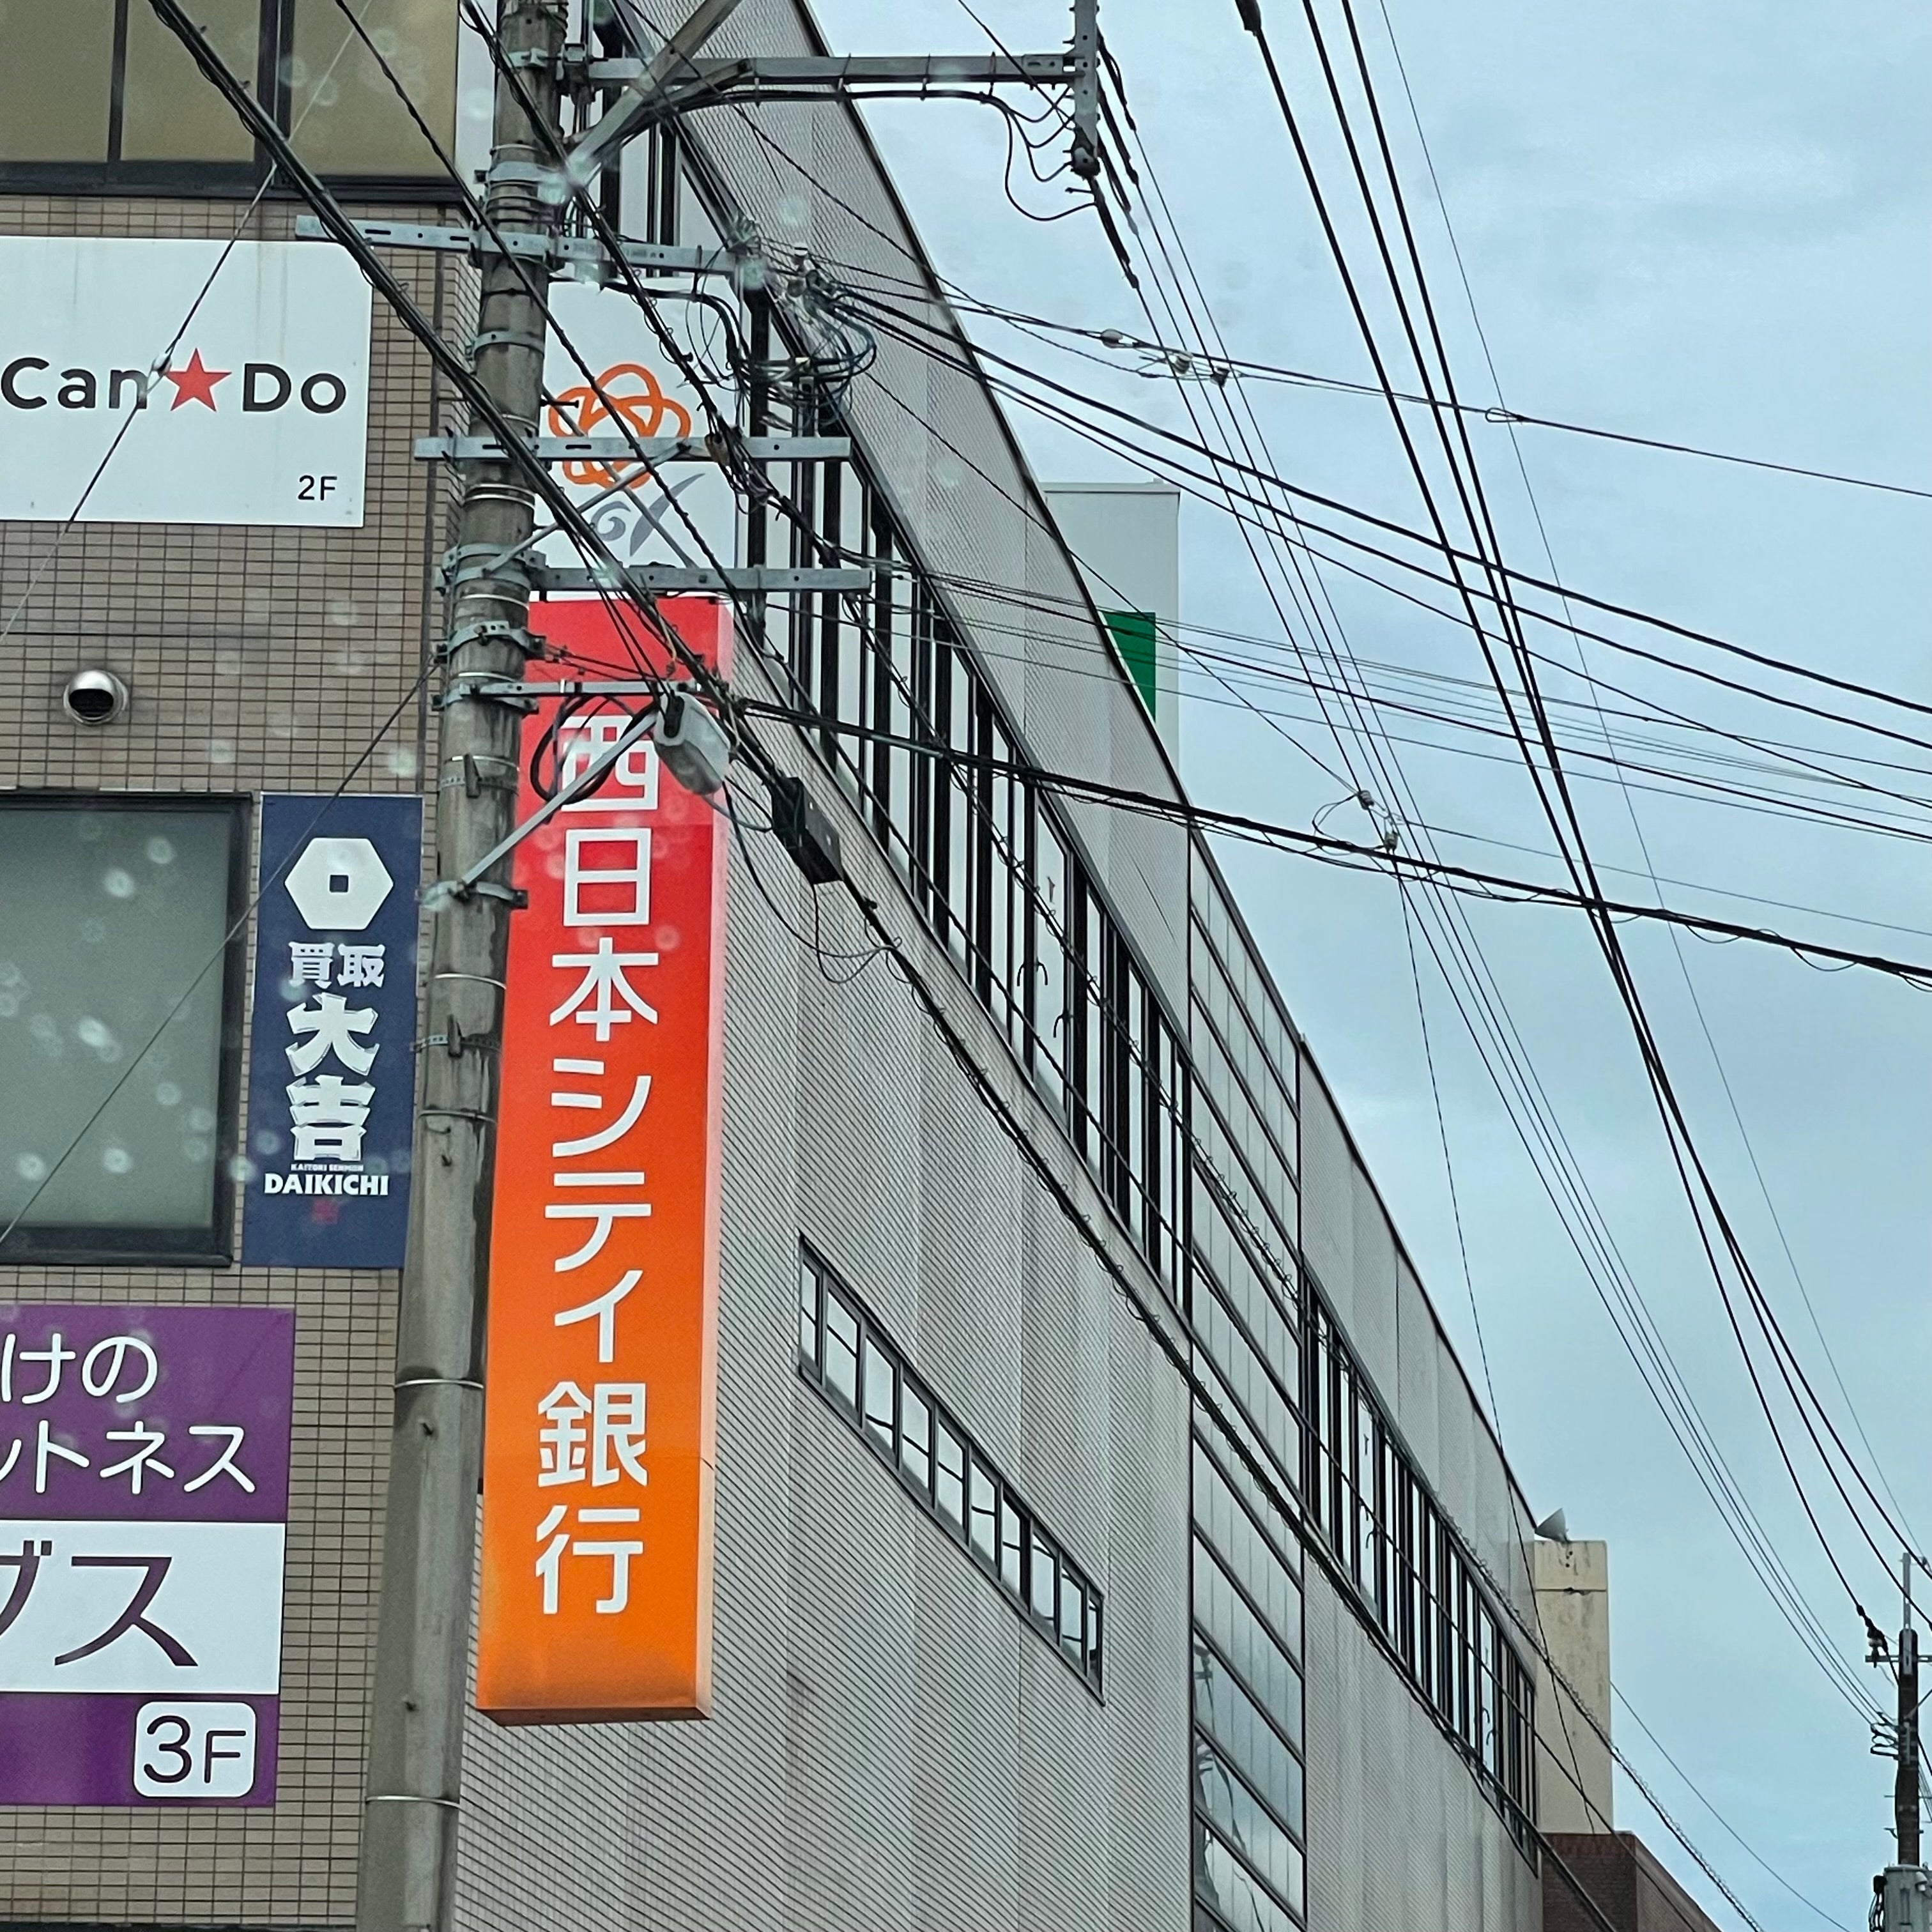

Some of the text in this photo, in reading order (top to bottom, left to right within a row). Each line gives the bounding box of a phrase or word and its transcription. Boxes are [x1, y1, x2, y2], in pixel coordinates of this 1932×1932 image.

[1, 357, 347, 413] Can Do
[298, 475, 338, 500] 2F
[288, 942, 385, 989] 買取
[285, 992, 379, 1162] 大吉
[264, 1173, 389, 1195] DAIKICHI
[535, 714, 659, 1614] 西日本シティ銀行
[0, 1333, 158, 1404] けの
[143, 1715, 247, 1784] 3F
